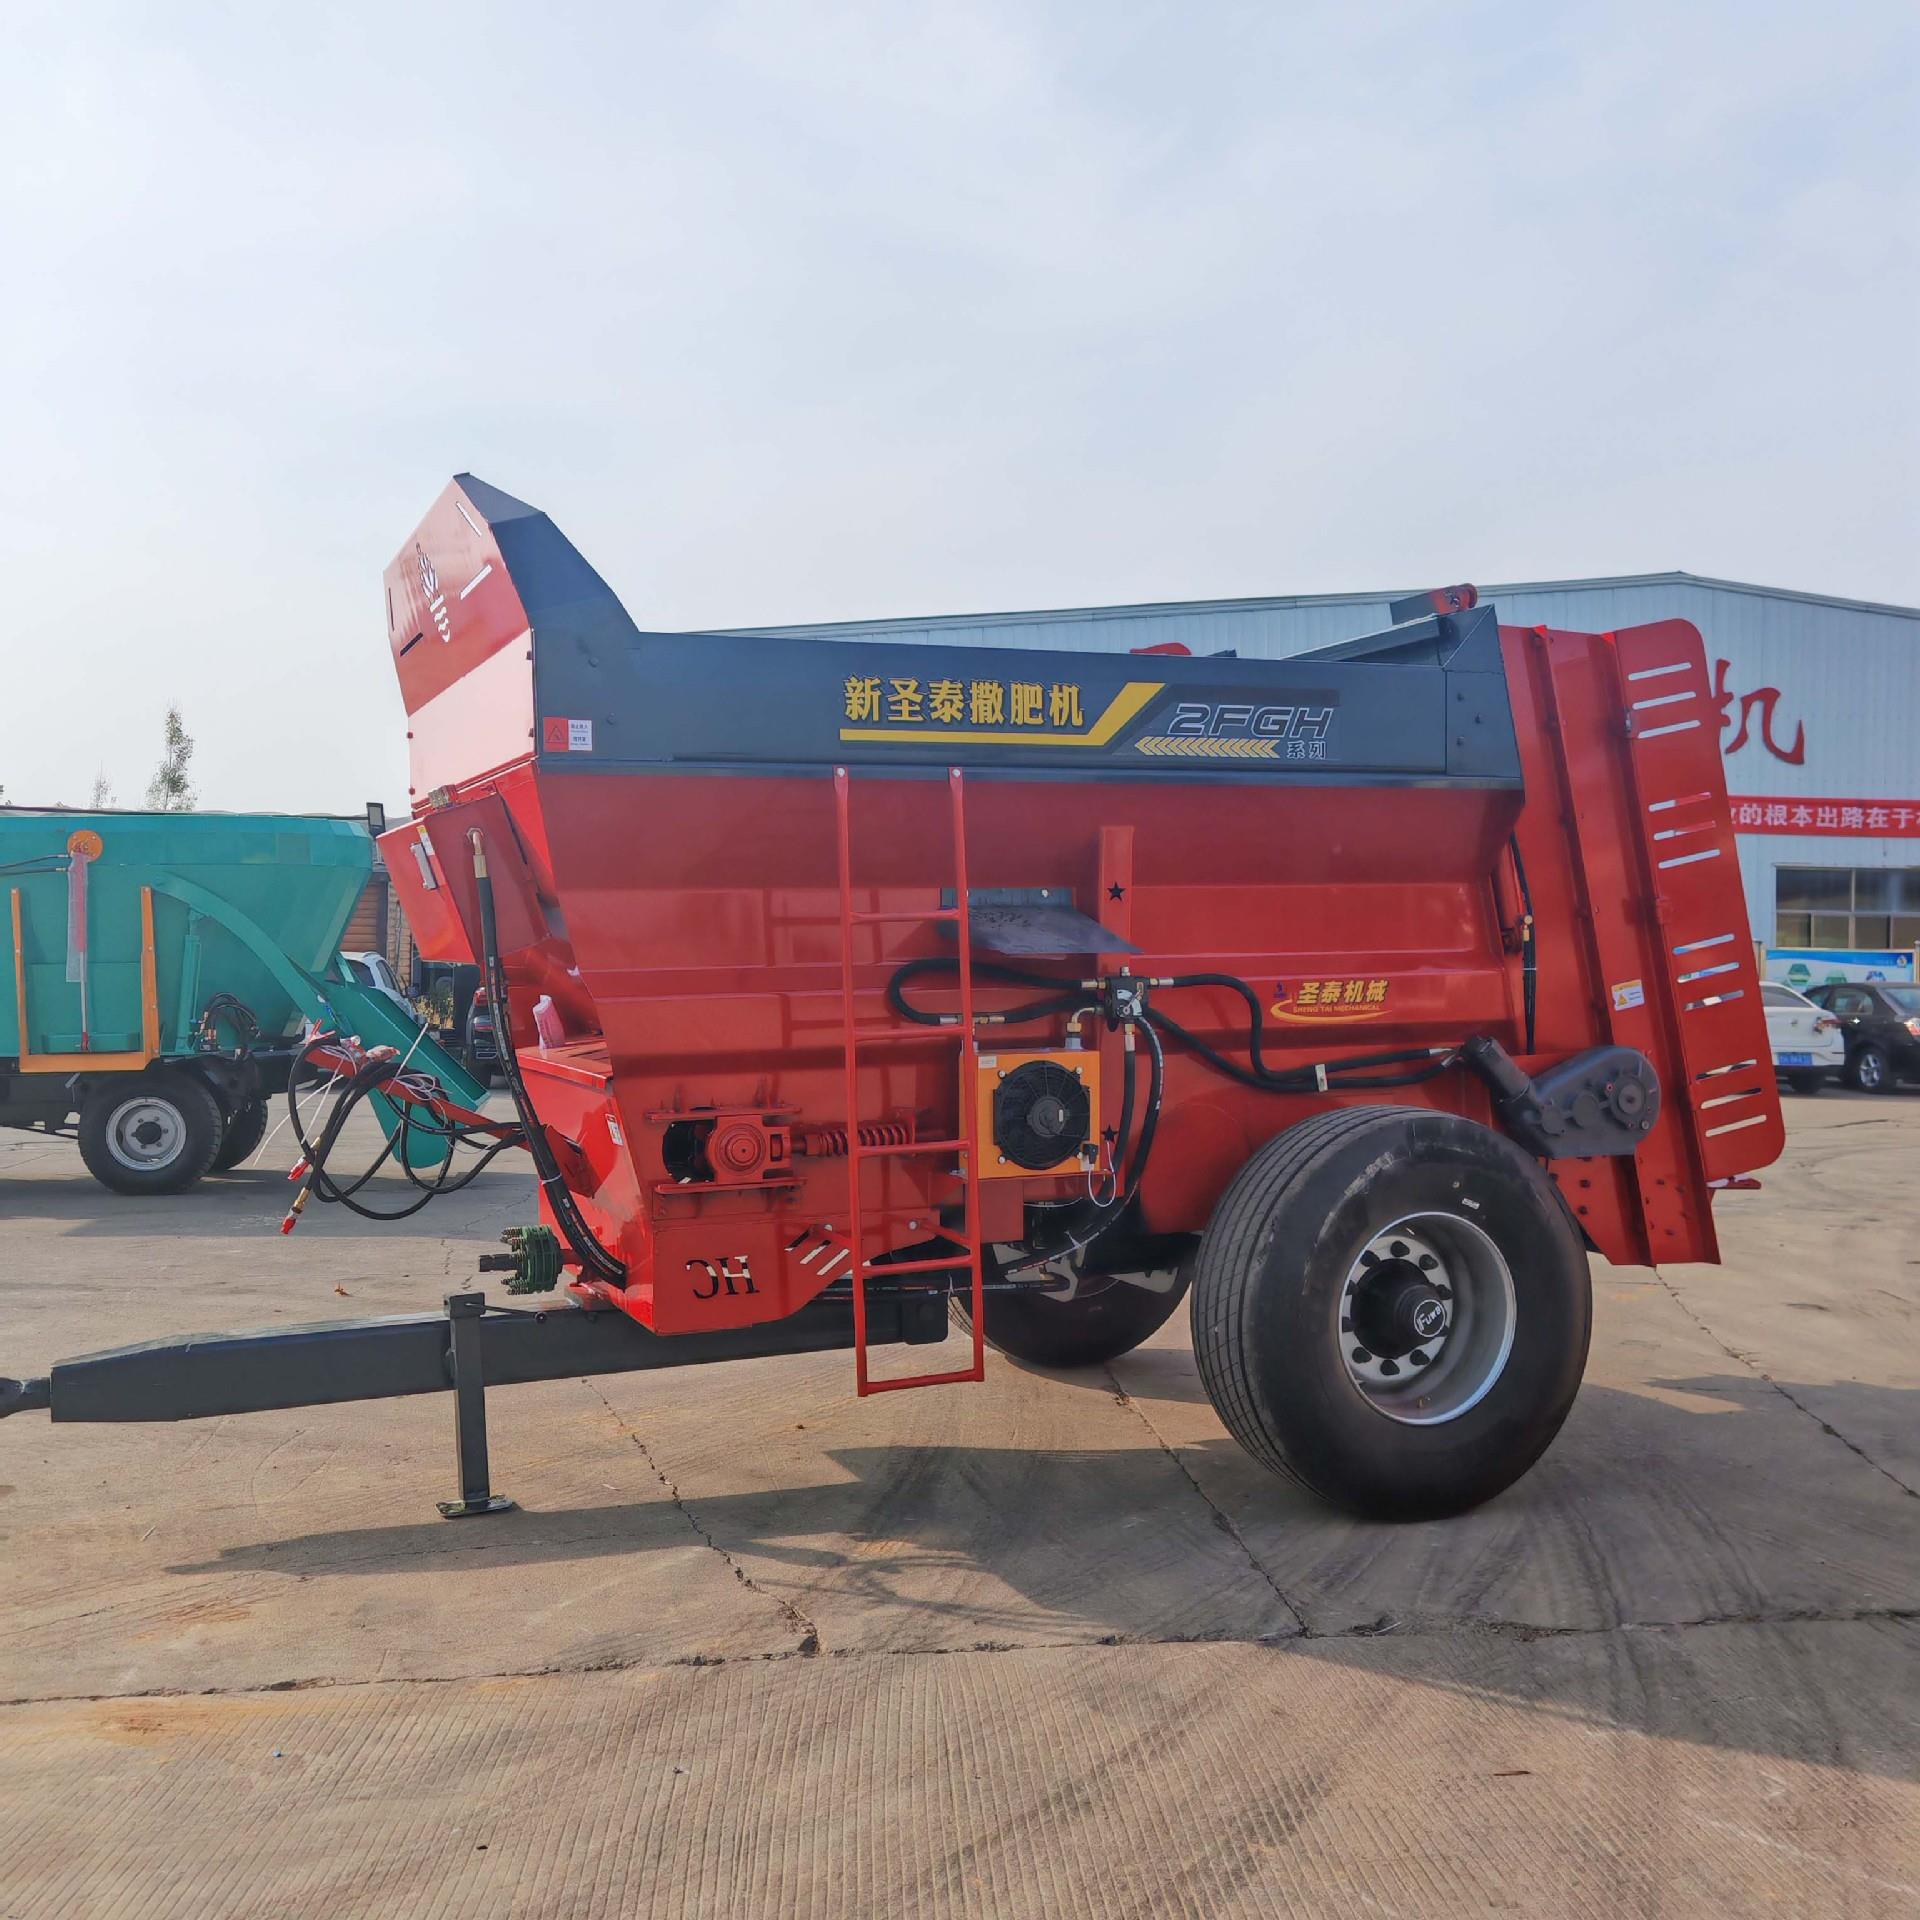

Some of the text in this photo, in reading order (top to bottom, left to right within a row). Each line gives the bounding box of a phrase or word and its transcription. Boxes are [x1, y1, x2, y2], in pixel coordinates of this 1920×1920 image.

[844, 675, 1084, 727] 新圣泰撒肥机
[1167, 703, 1334, 739] 2FGH
[1286, 741, 1326, 760] 系列
[1731, 803, 1920, 829] 的根本出路在于
[1297, 980, 1388, 1005] 圣泰机械
